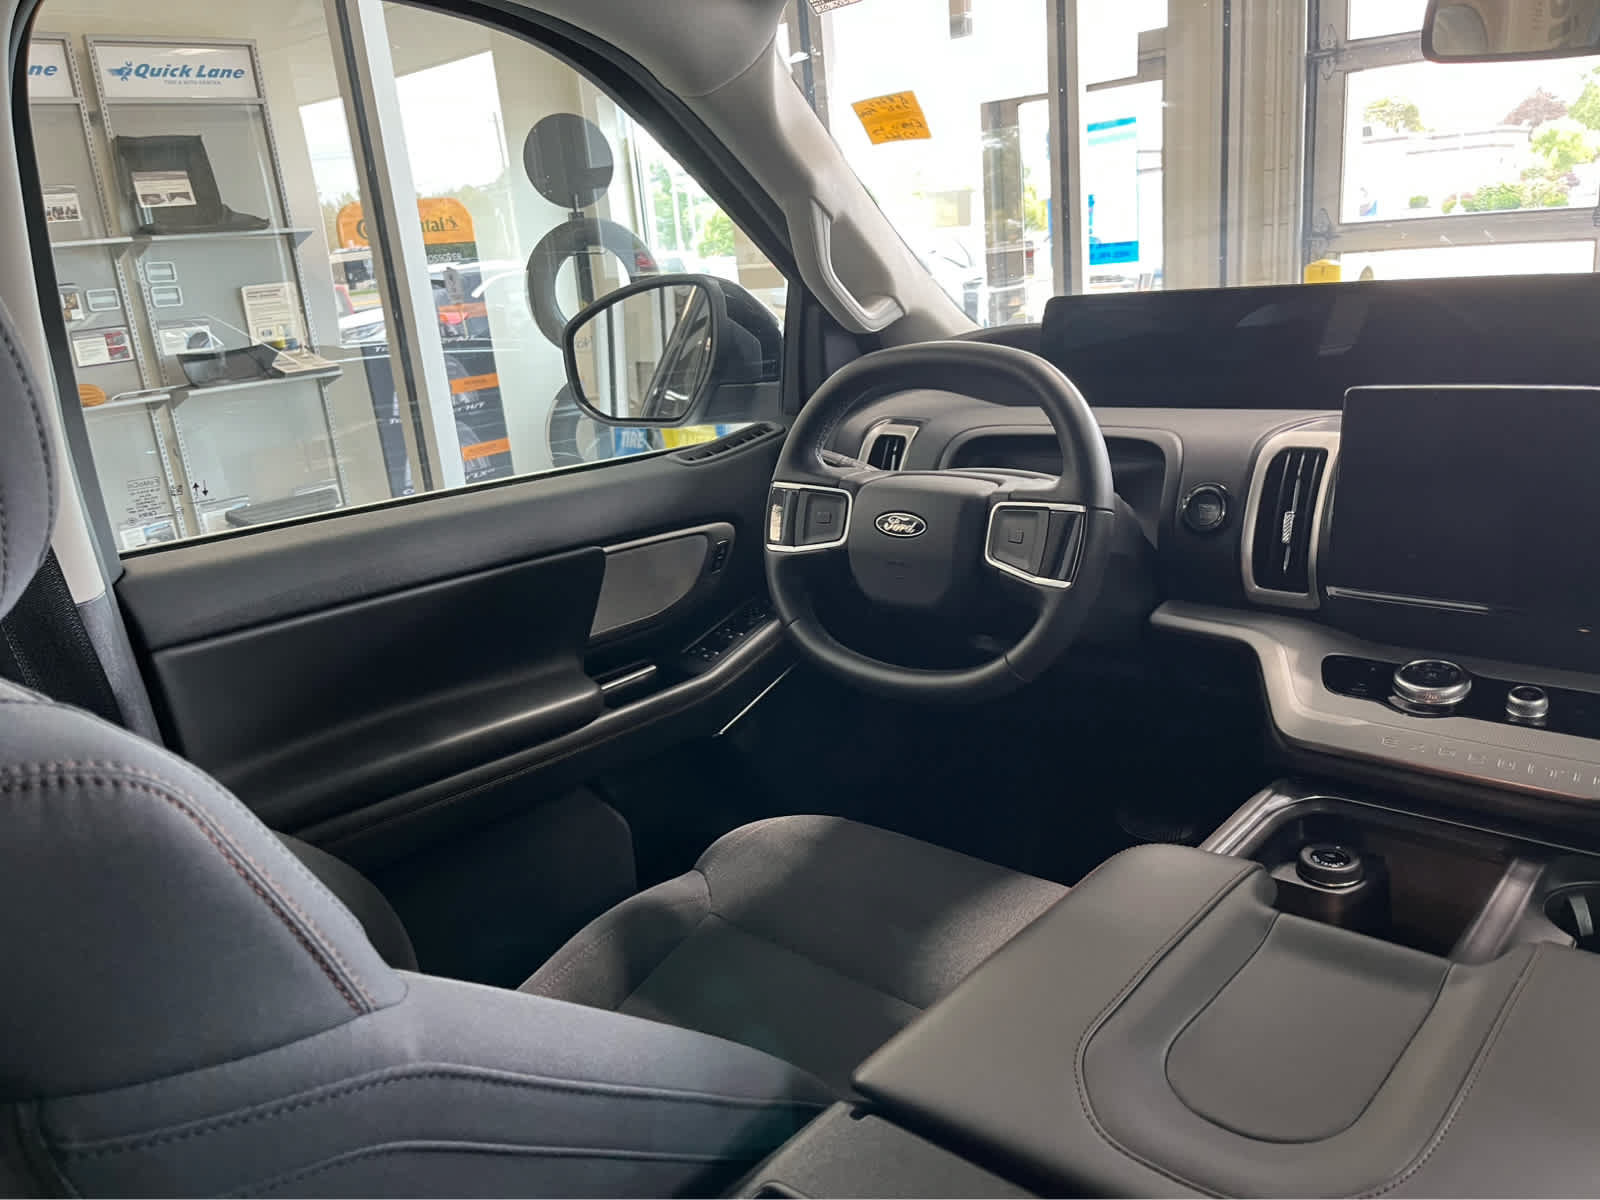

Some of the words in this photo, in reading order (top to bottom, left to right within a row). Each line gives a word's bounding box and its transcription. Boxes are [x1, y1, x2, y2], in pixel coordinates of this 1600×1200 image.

[28, 65, 58, 76] ne
[133, 63, 192, 80] Quick
[196, 64, 245, 80] Lane
[883, 515, 917, 533] Ford
